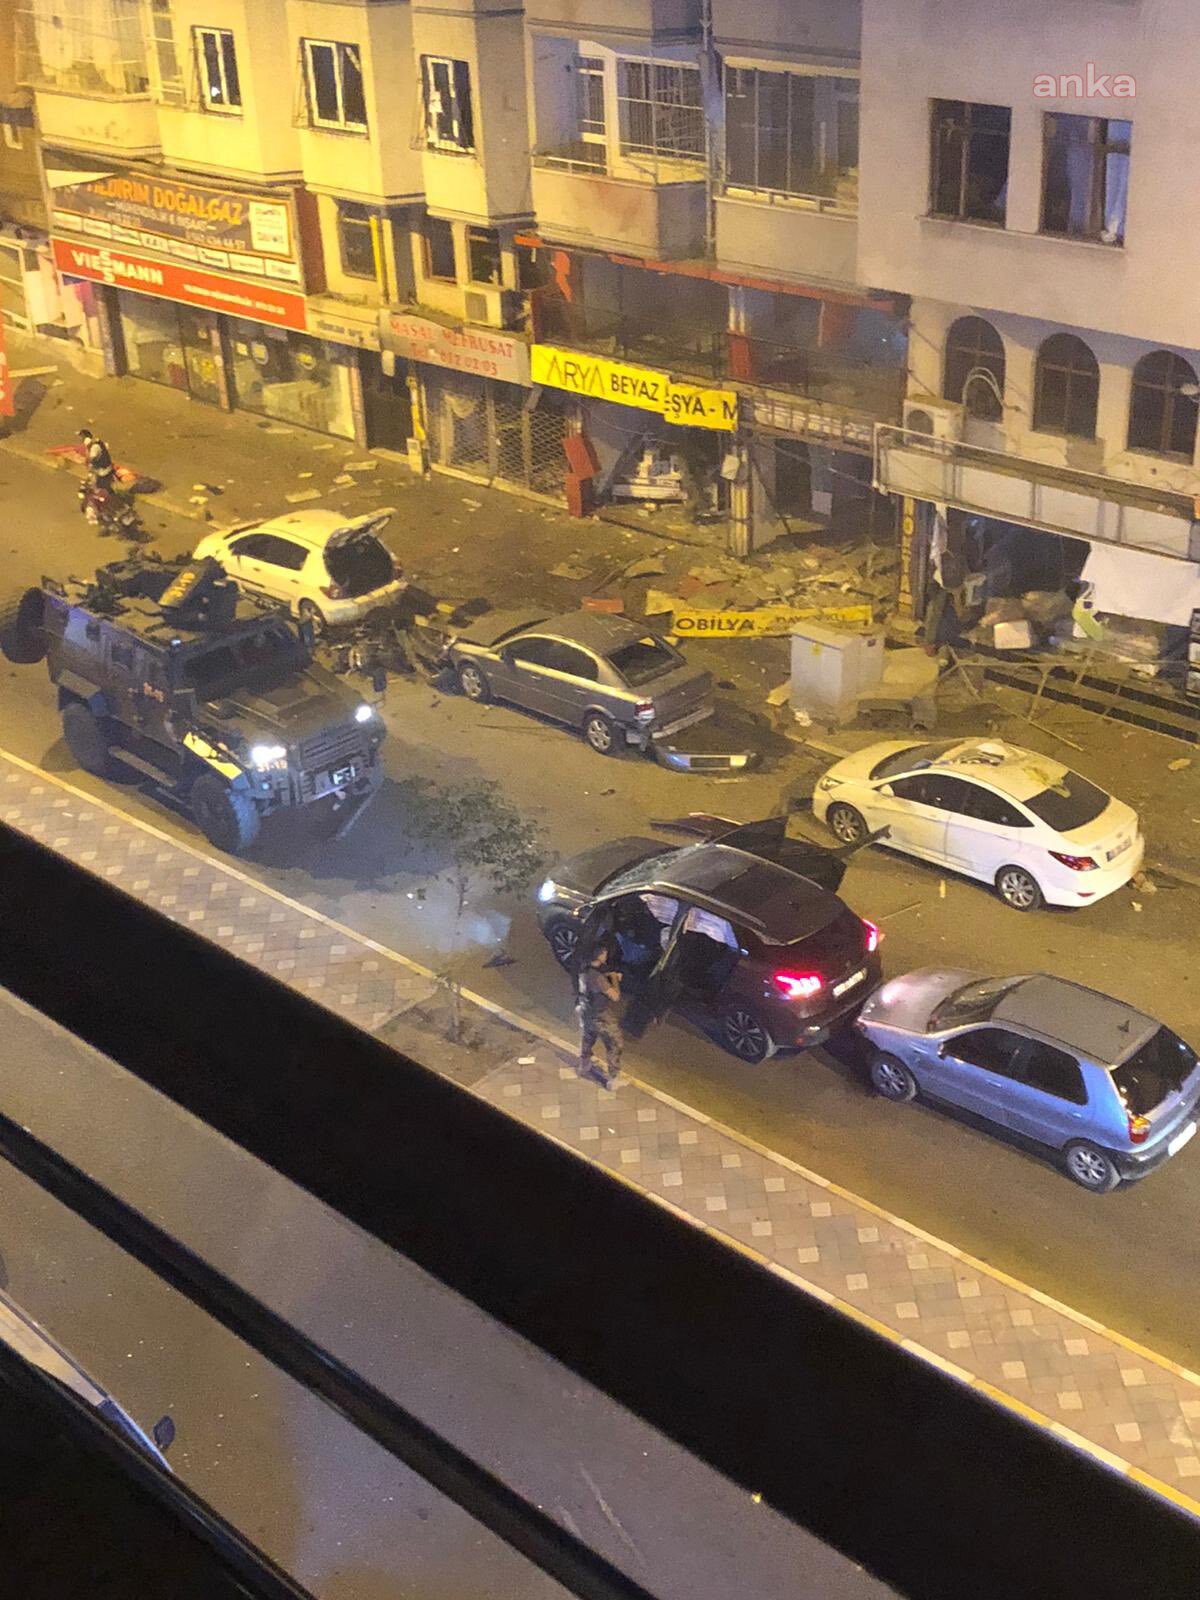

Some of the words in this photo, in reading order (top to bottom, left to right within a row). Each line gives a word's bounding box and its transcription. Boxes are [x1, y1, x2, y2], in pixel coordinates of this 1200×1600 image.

[71, 249, 163, 285] VIESSMANN
[547, 355, 604, 394] ARYA
[611, 374, 658, 401] BEYAZ
[676, 615, 754, 631] OBİLYA
